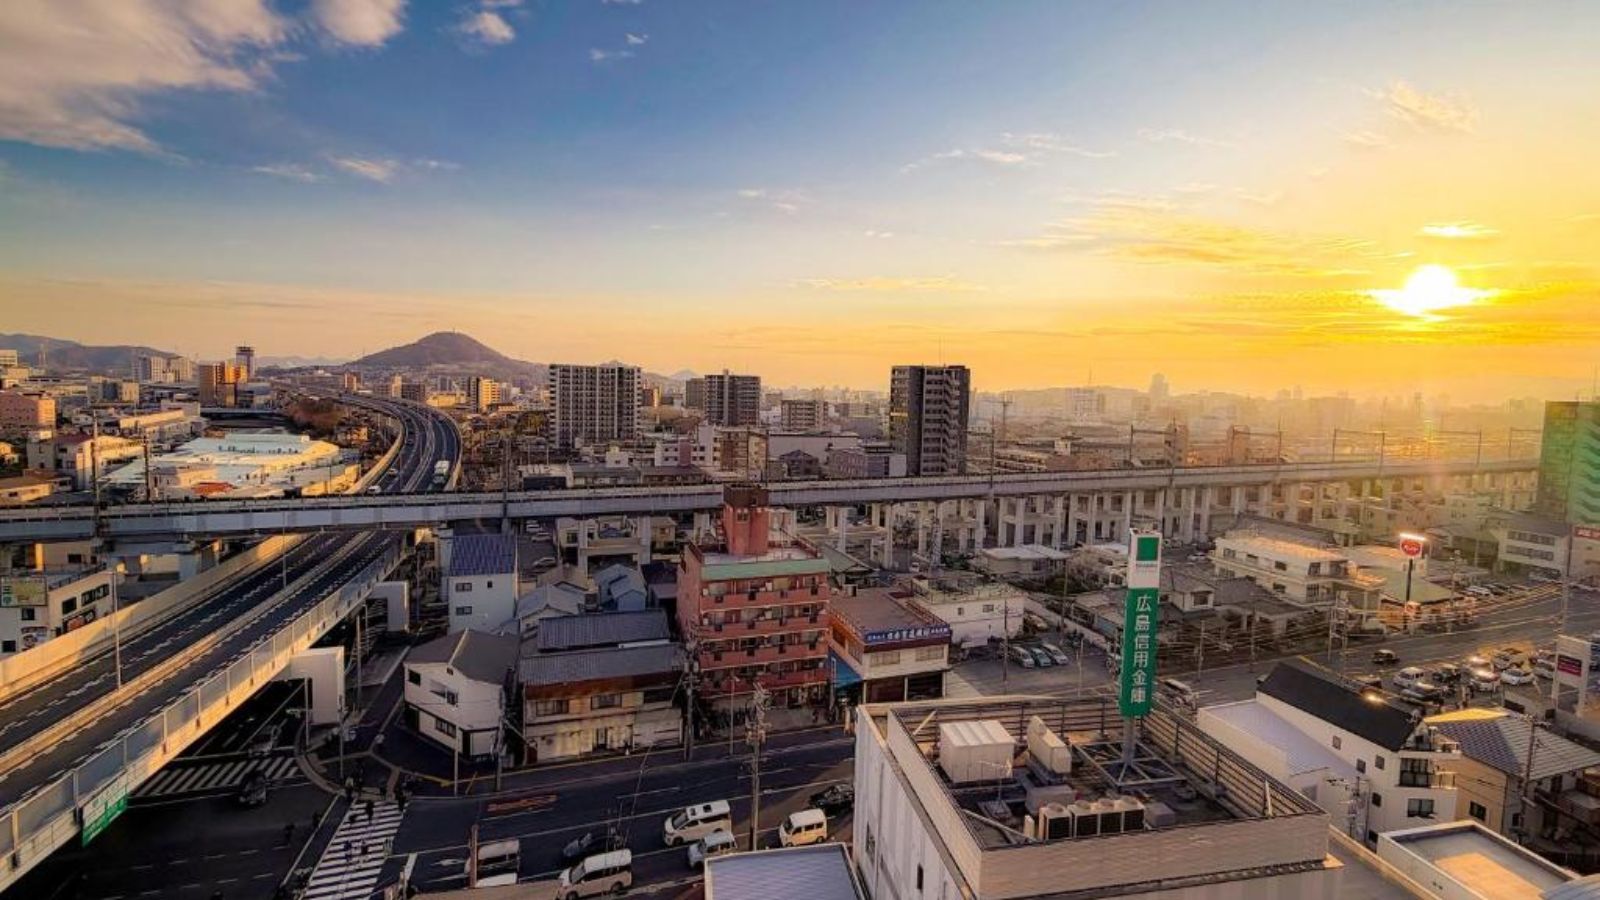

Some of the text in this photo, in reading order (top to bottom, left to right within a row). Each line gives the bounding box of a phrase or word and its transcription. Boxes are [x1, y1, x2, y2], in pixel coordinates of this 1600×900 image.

[1131, 595, 1152, 704] 広島信用金庫
